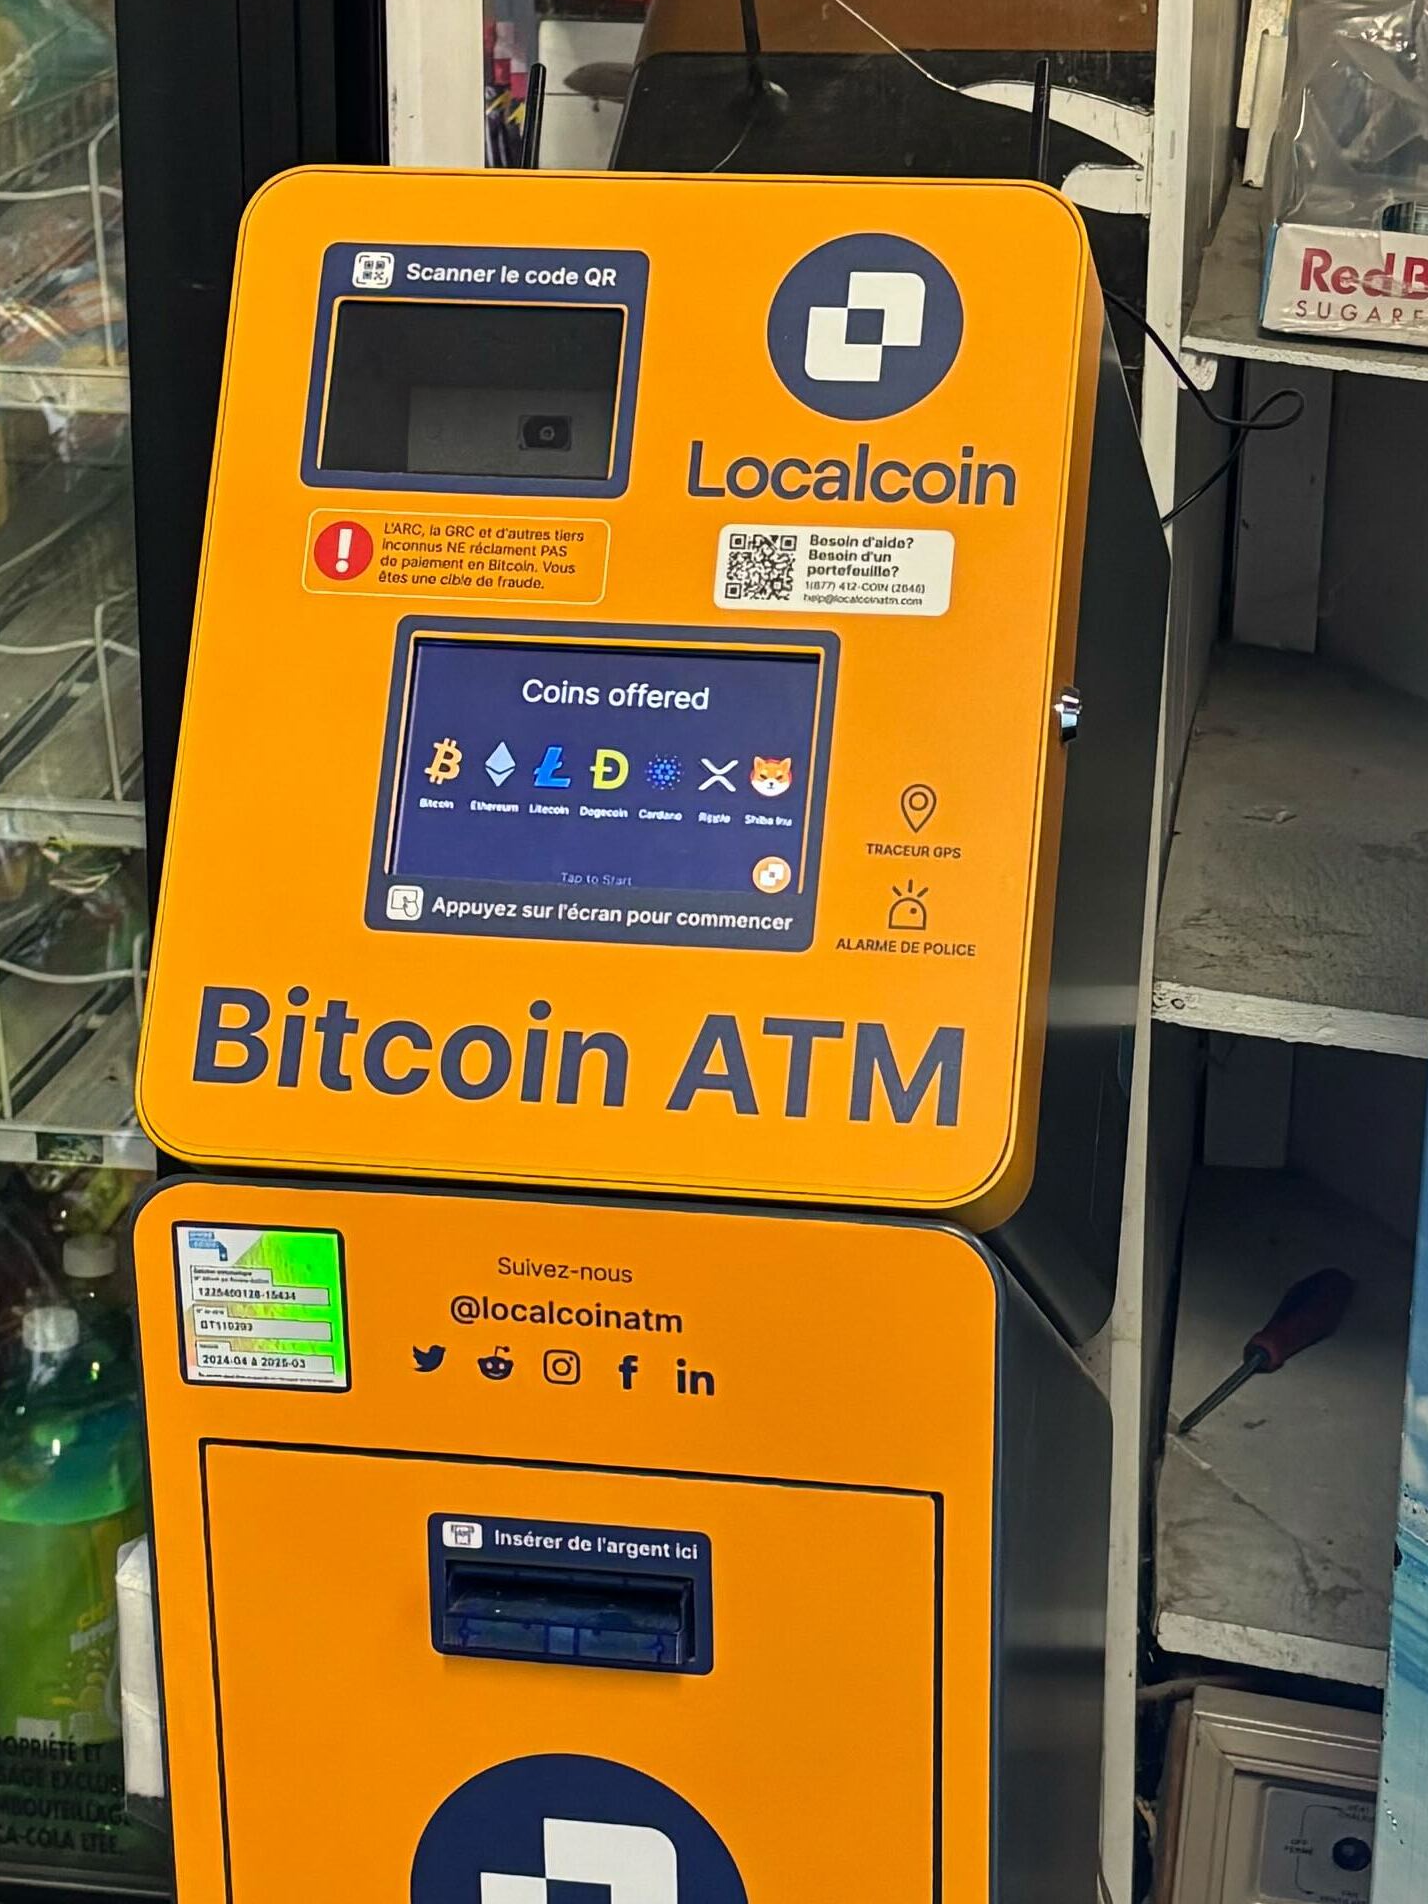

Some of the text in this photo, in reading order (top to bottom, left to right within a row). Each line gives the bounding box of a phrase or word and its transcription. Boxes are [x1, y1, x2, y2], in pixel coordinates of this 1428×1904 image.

[406, 262, 618, 290] Scanner le code QR
[687, 442, 1017, 508] Localcoin
[383, 521, 425, 538] L'ARC,
[445, 525, 475, 538] GRC
[496, 527, 550, 541] d'autres
[447, 541, 466, 554] NE
[540, 545, 568, 558] PAS
[861, 551, 892, 563] d'un
[522, 677, 711, 712] Coins offered
[866, 842, 962, 860] TRACEUR GPS
[560, 871, 583, 887] Tap
[602, 873, 633, 887] Start
[432, 895, 793, 932] Appuyez sur l'écran pour commencer
[836, 938, 977, 957] ALARME DE POLICE
[192, 984, 967, 1128] Bitcoin ATM
[497, 1256, 634, 1285] Suivez-nous
[450, 1294, 684, 1336] @localcoinatm
[494, 1528, 699, 1561] Insérer de l'argent ici
